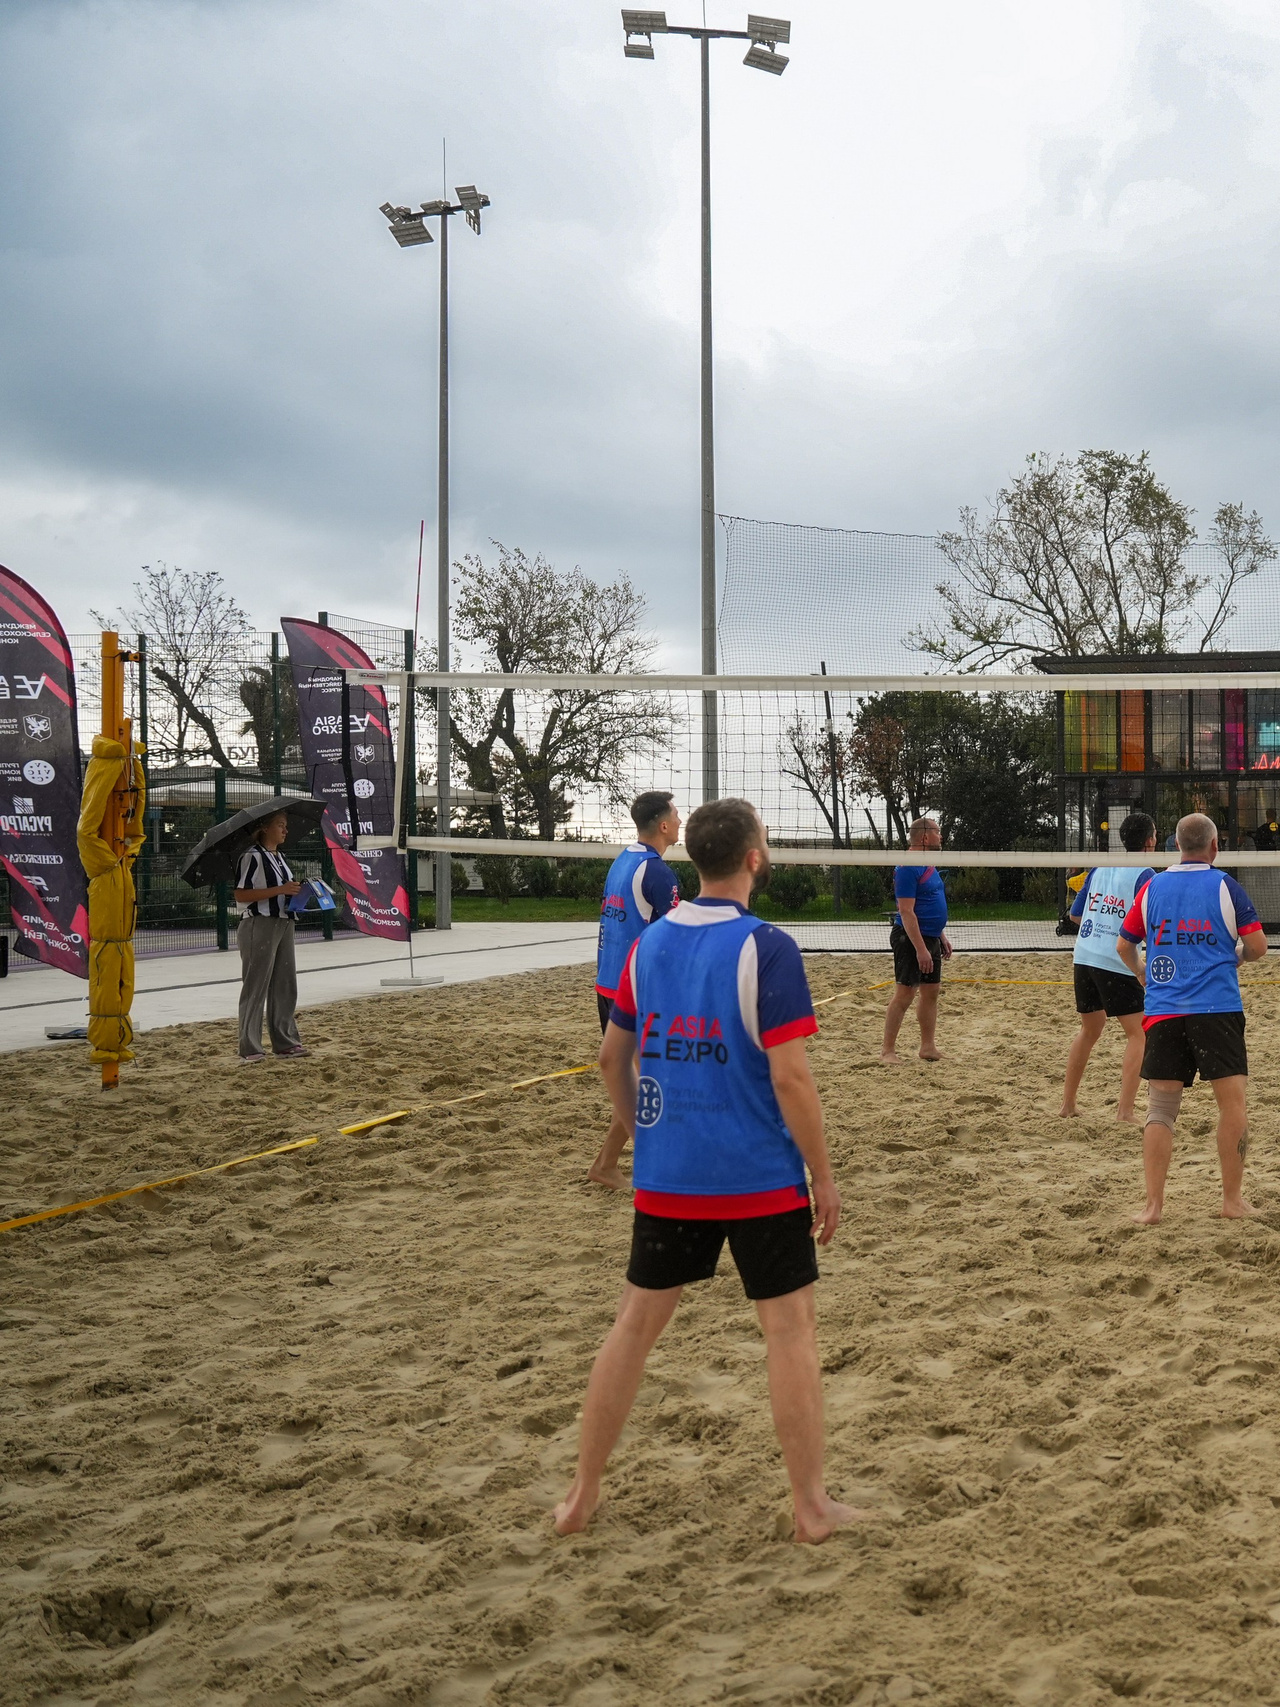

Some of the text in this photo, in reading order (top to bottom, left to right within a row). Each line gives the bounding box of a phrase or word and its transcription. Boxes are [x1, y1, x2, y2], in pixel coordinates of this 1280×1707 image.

[1103, 895, 1125, 909] ASIA
[1100, 904, 1126, 919] EXPO
[1176, 918, 1213, 932] ASIA
[1176, 932, 1218, 946] EXPO
[667, 1014, 723, 1040] ASIA
[665, 1038, 728, 1065] EXPO
